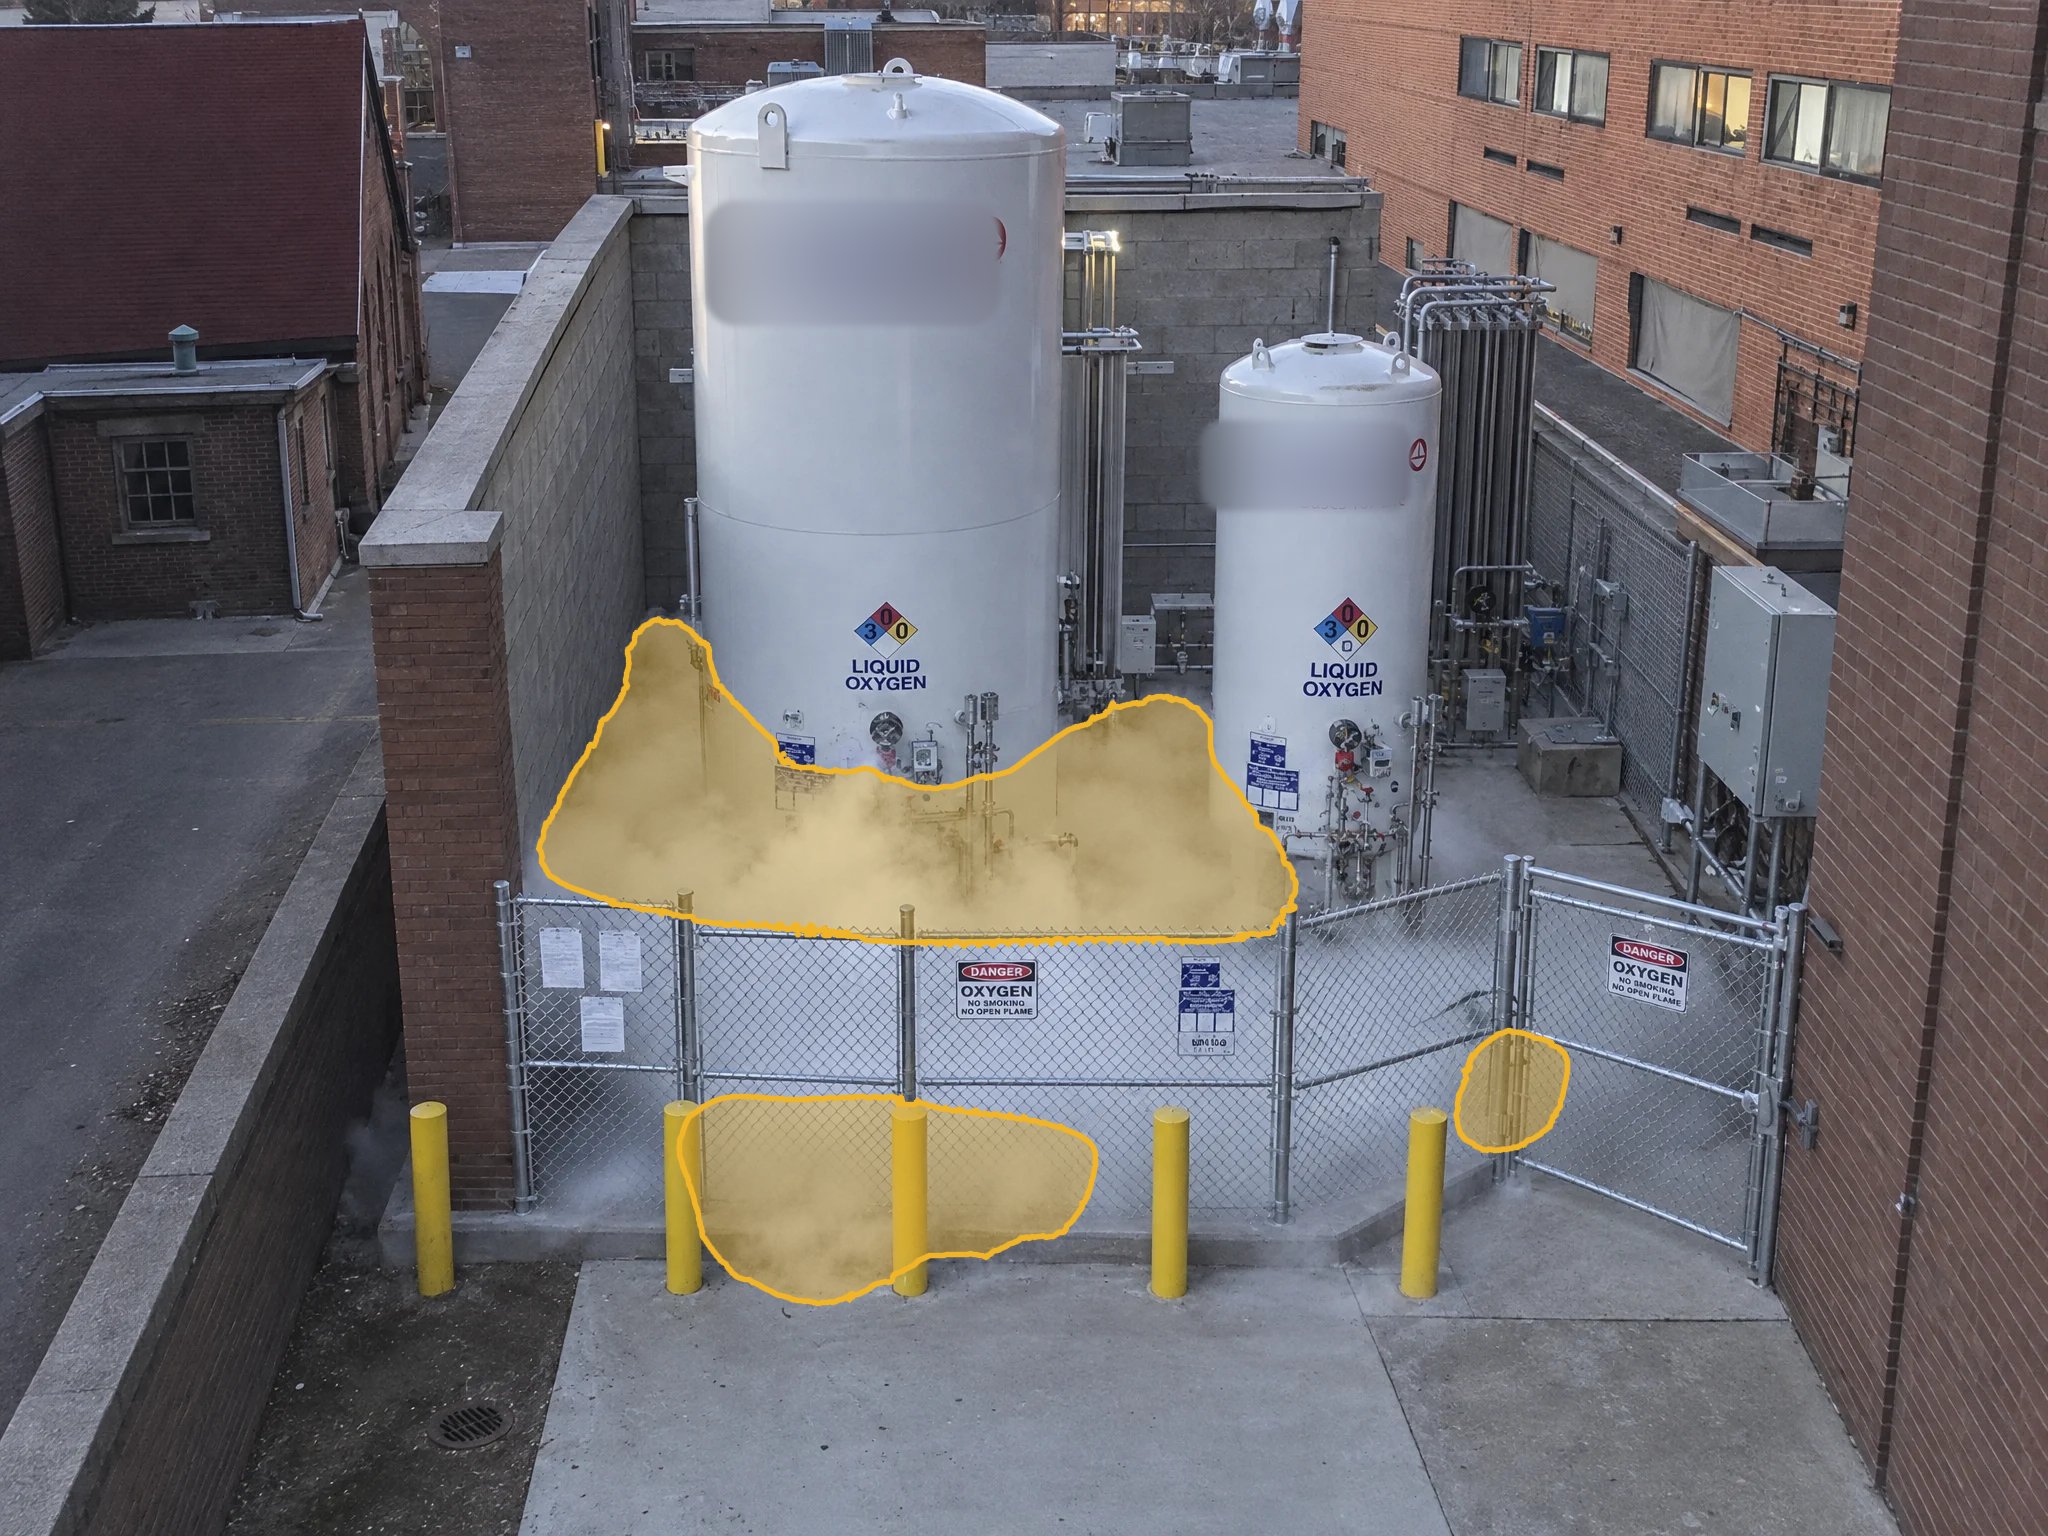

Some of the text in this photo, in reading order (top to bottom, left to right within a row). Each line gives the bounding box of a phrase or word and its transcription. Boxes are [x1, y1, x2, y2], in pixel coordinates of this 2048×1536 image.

[880, 608, 892, 625] 0
[1341, 604, 1354, 623] 0
[864, 622, 908, 640] 3 0
[1324, 619, 1369, 638] 3 0
[852, 659, 920, 675] LIQUID
[1310, 662, 1378, 679] LIQUID
[845, 675, 927, 691] OXYGEN
[1303, 680, 1383, 697] OXYGEN
[1623, 943, 1675, 965] DANGER
[971, 967, 1023, 977] DANGER
[1613, 960, 1683, 988] OXYGEN
[1619, 977, 1631, 985] NO
[961, 985, 1033, 998] OXYGEN
[1612, 983, 1624, 992] NO
[1627, 987, 1650, 998] OPEN
